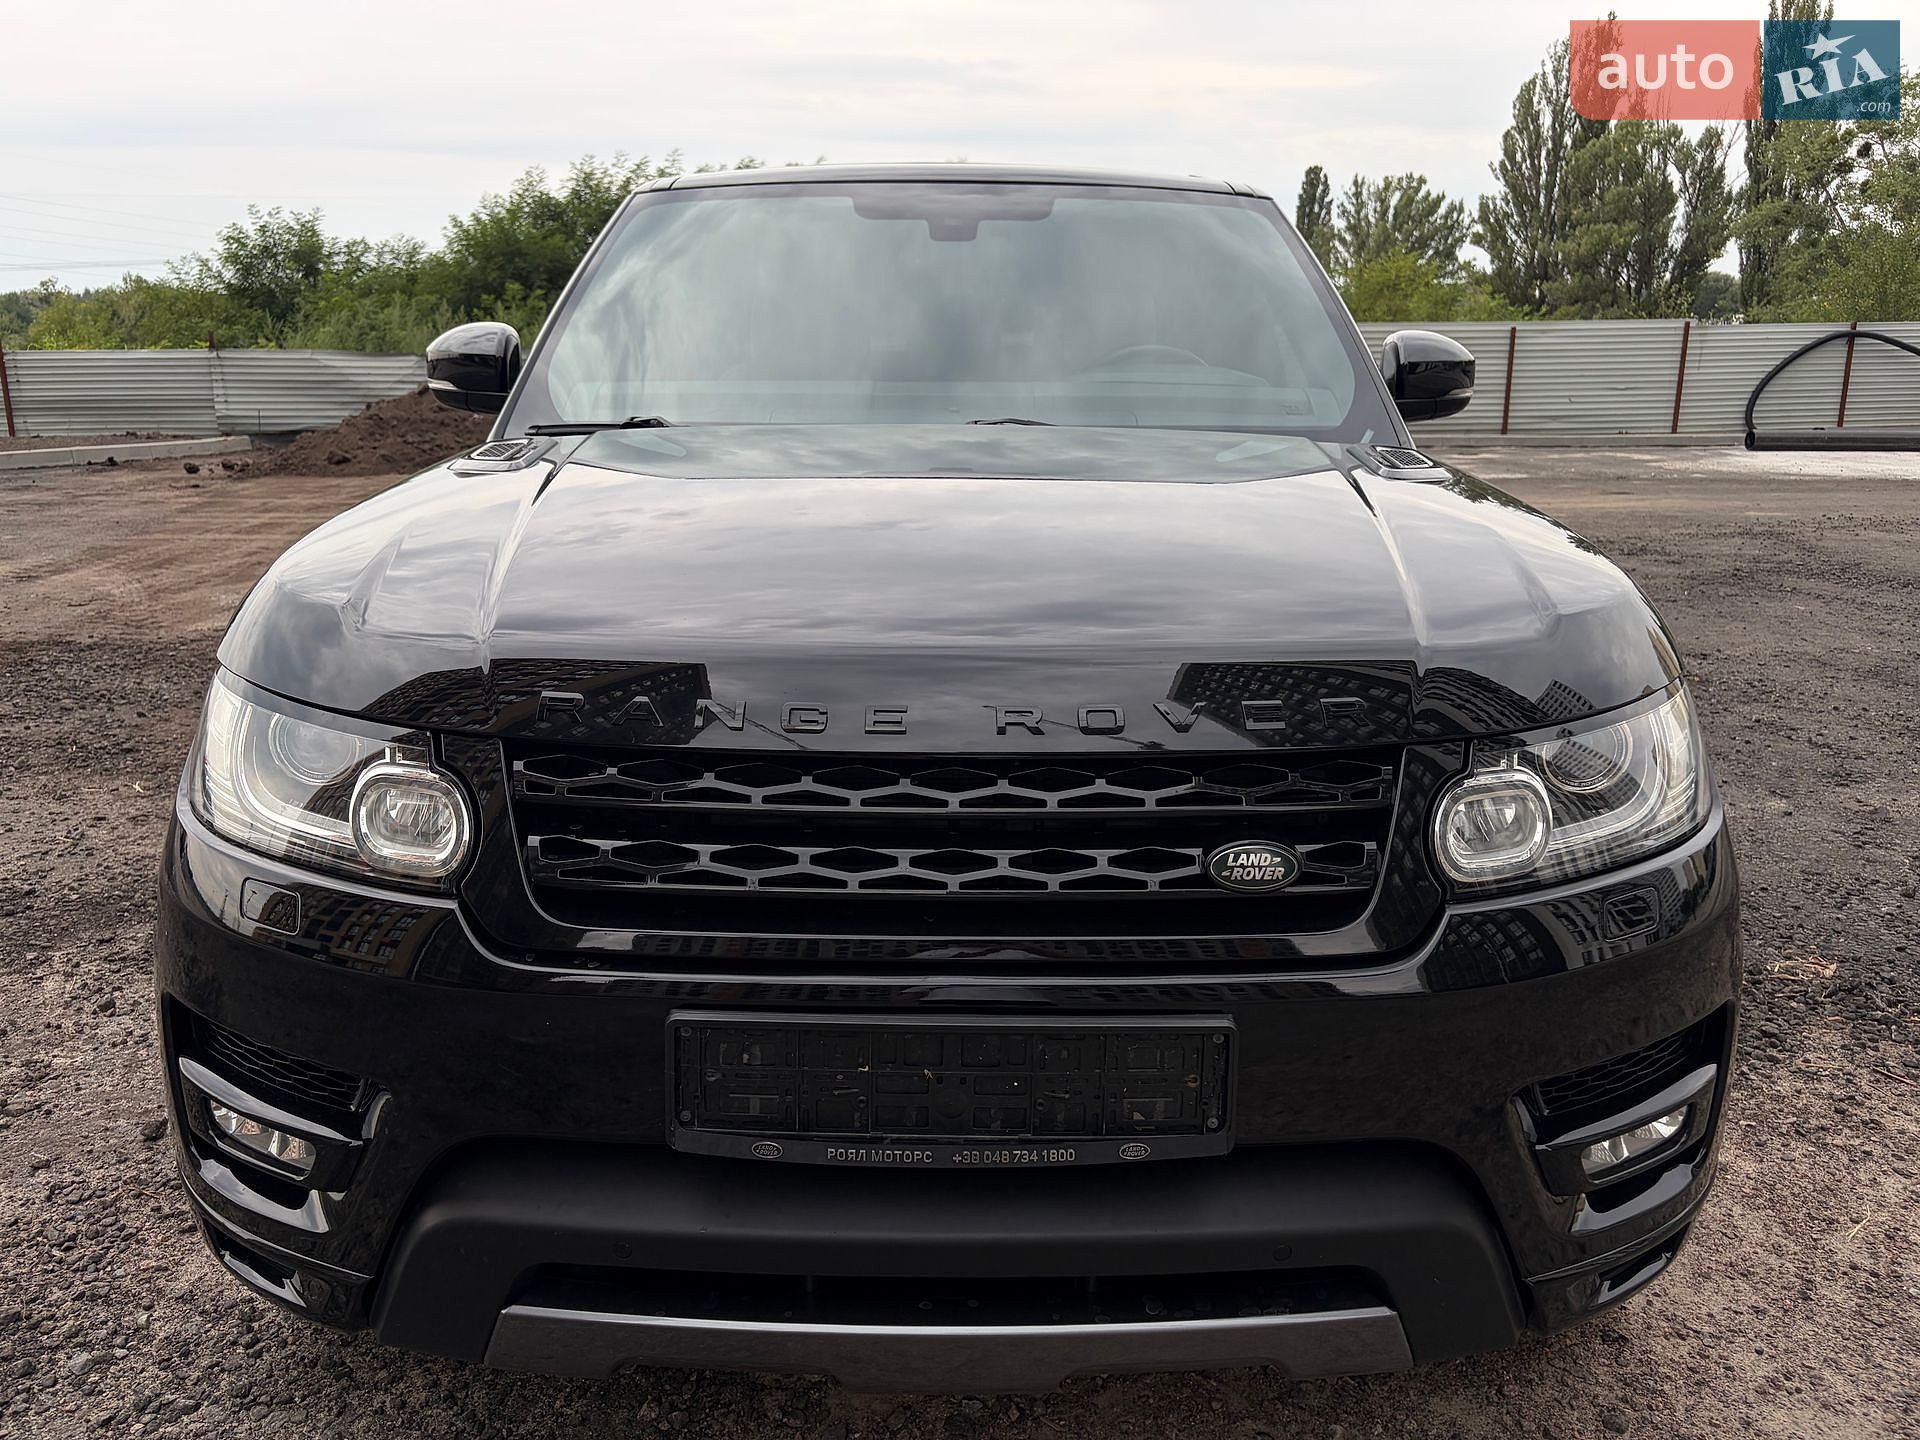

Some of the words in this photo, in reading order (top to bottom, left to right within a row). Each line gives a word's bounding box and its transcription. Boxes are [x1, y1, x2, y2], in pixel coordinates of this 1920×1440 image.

[536, 691, 909, 734] RANGE
[995, 697, 1371, 736] ROVER
[1227, 853, 1272, 867] LAND
[1231, 867, 1285, 880] ROVER
[827, 1148, 866, 1161] РОЯЛ
[871, 1150, 933, 1163] МОТОРС
[983, 1150, 1010, 1163] 048
[1012, 1150, 1039, 1162] 734
[1042, 1149, 1076, 1161] 1800
